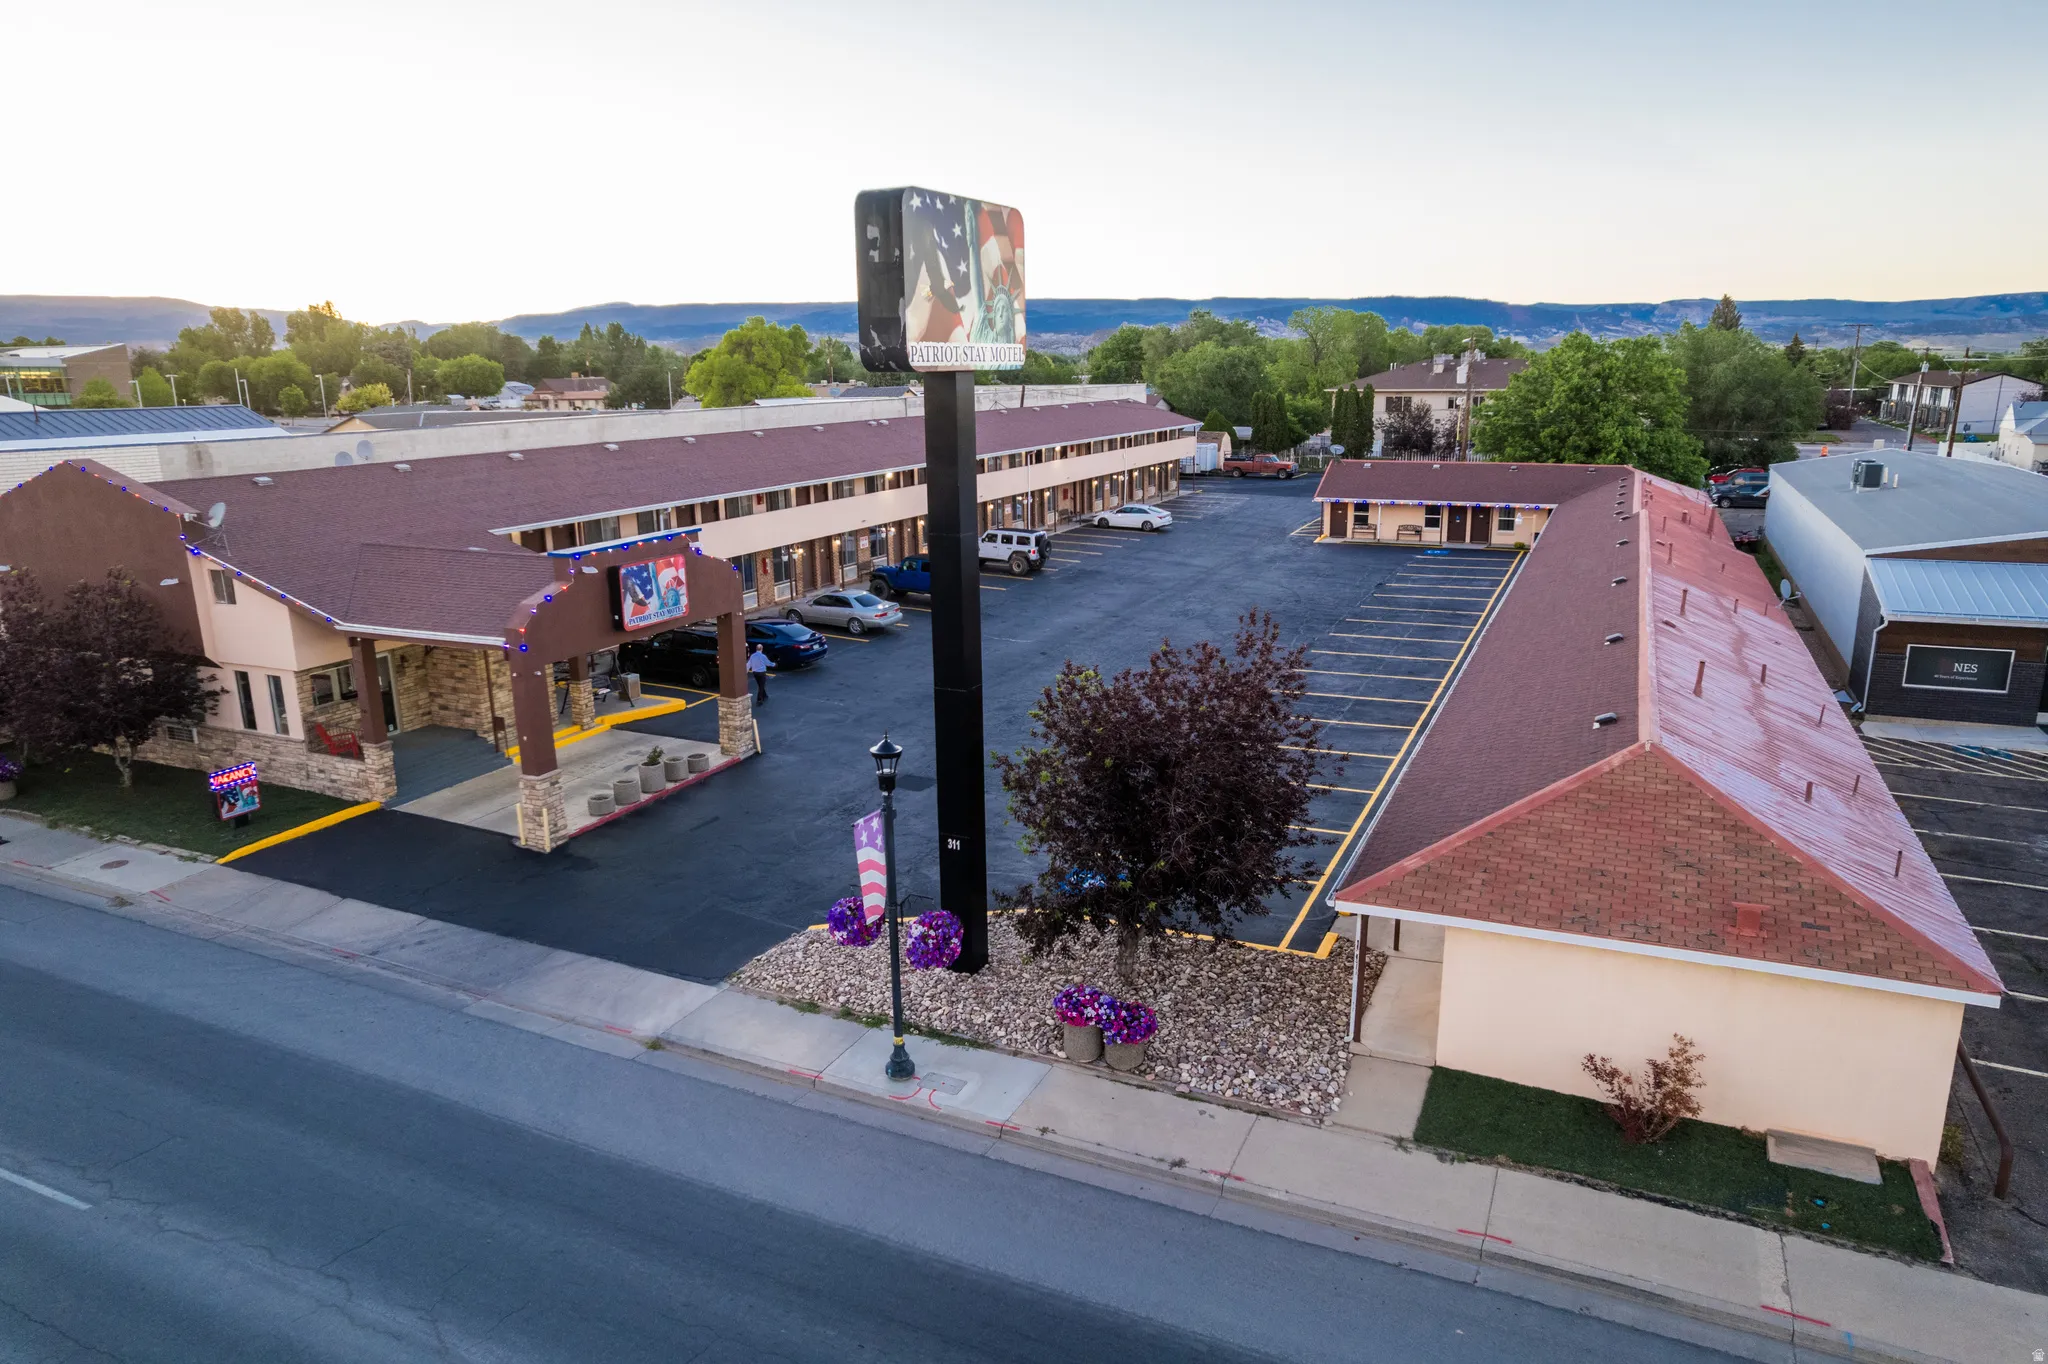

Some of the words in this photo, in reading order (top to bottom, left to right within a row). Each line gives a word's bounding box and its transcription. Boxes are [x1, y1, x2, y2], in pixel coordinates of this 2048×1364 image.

[910, 345, 960, 362] PATRIOT
[963, 346, 987, 362] STAY
[990, 347, 1024, 362] MOTEL
[629, 613, 652, 625] PATRIOT
[653, 610, 665, 619] STAY
[667, 605, 685, 615] MOTEL
[1953, 663, 1978, 673] NES
[213, 767, 253, 786] VACANCY
[948, 838, 960, 850] 311
